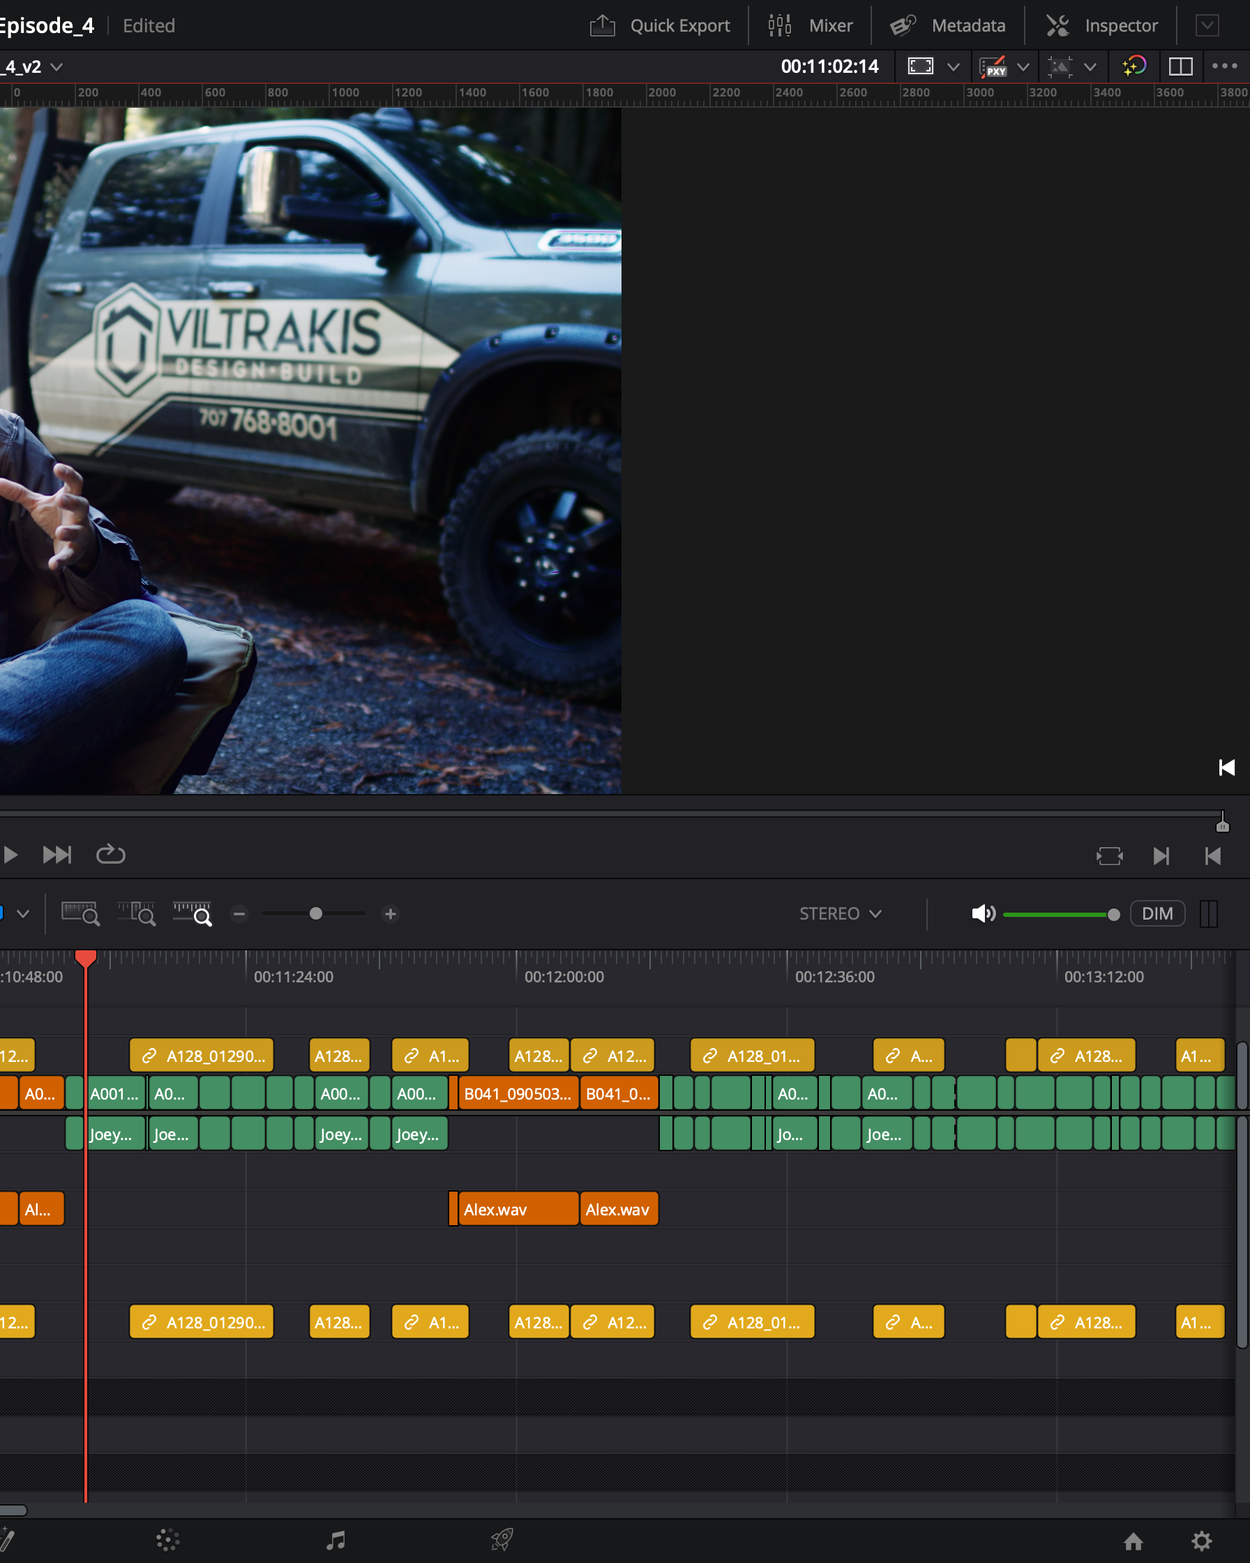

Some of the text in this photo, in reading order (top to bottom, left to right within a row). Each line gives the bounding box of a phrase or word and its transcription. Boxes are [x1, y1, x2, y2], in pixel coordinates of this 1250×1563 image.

[123, 17, 175, 33] Edited
[630, 18, 731, 37] Quick Export
[810, 18, 854, 33] Mixer
[932, 17, 1006, 33] Metadata
[1086, 18, 1159, 37] Inspector
[781, 58, 880, 74] 00:11:02:14
[987, 67, 1006, 76] PXY
[13, 87, 21, 98] 0
[77, 87, 99, 98] 200
[140, 87, 162, 98] 400
[204, 87, 226, 98] 600
[267, 87, 289, 98] 800
[332, 87, 360, 98] 1000
[395, 87, 423, 98] 1200
[459, 87, 487, 98] 1400
[522, 87, 550, 98] 1600
[586, 87, 614, 98] 1800
[648, 87, 677, 98] 2000
[712, 87, 741, 98] 2200
[775, 87, 804, 98] 2400
[839, 87, 868, 98] 2600
[902, 87, 931, 98] 2800
[966, 87, 995, 98] 3000
[1029, 87, 1058, 98] 3200
[1093, 87, 1122, 98] 3400
[1156, 87, 1184, 98] 3600
[1220, 87, 1249, 98] 3800
[167, 307, 382, 356] VILTRAKIS
[198, 407, 230, 428] 707
[799, 906, 860, 921] STEREO
[1142, 906, 1173, 921] DIM
[254, 970, 334, 983] 00:11:24:00
[524, 970, 605, 983] 00:12:00:00
[795, 970, 876, 983] 00:12:36:00
[1064, 970, 1145, 983] 00:13:12:00
[463, 1202, 528, 1216] Alex.wav
[585, 1202, 650, 1216] Alex.wav
